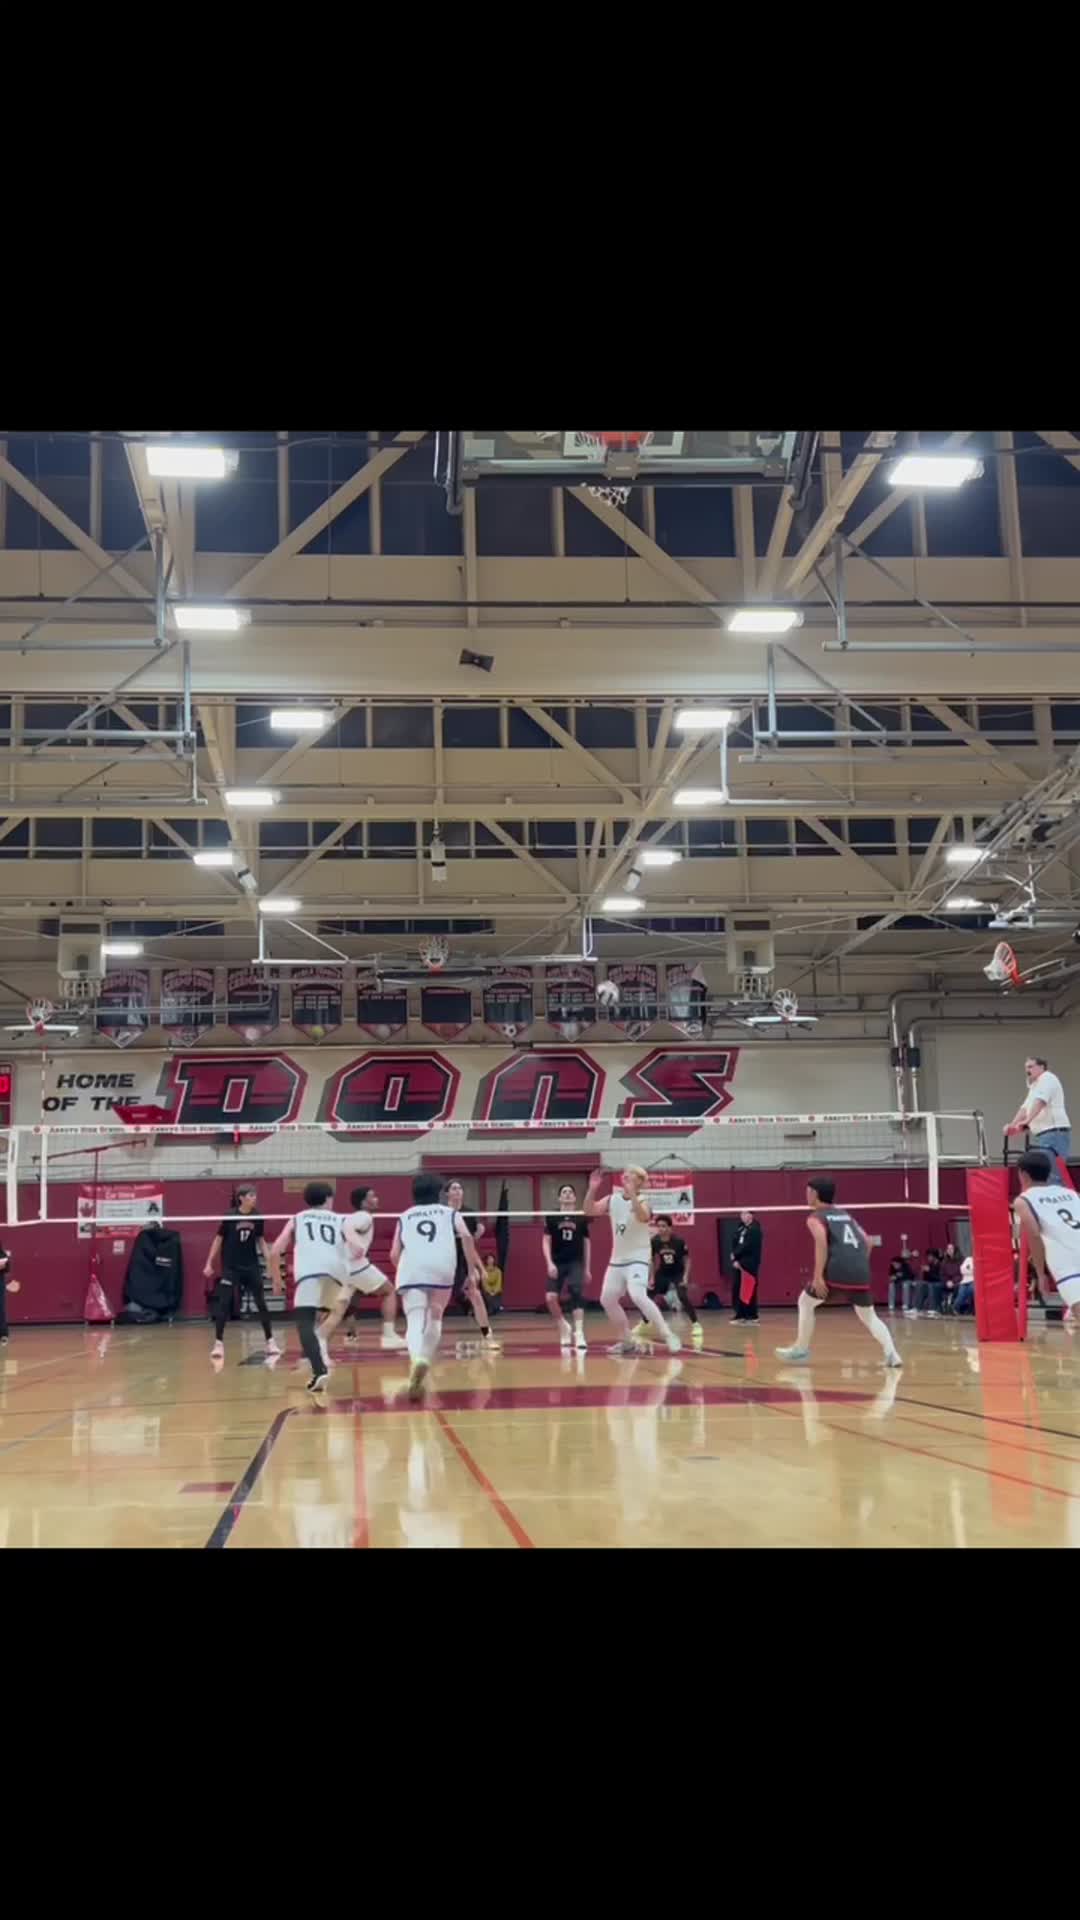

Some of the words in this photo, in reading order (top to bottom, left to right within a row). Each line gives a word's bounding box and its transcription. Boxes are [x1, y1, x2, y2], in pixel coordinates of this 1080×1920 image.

[56, 1073, 136, 1089] HOME
[158, 1046, 740, 1140] DONS
[42, 1096, 79, 1112] OF
[240, 1229, 250, 1243] 17
[304, 1221, 336, 1246] 10
[416, 1219, 437, 1244] 9
[562, 1229, 573, 1241] 13
[843, 1223, 859, 1249] 4
